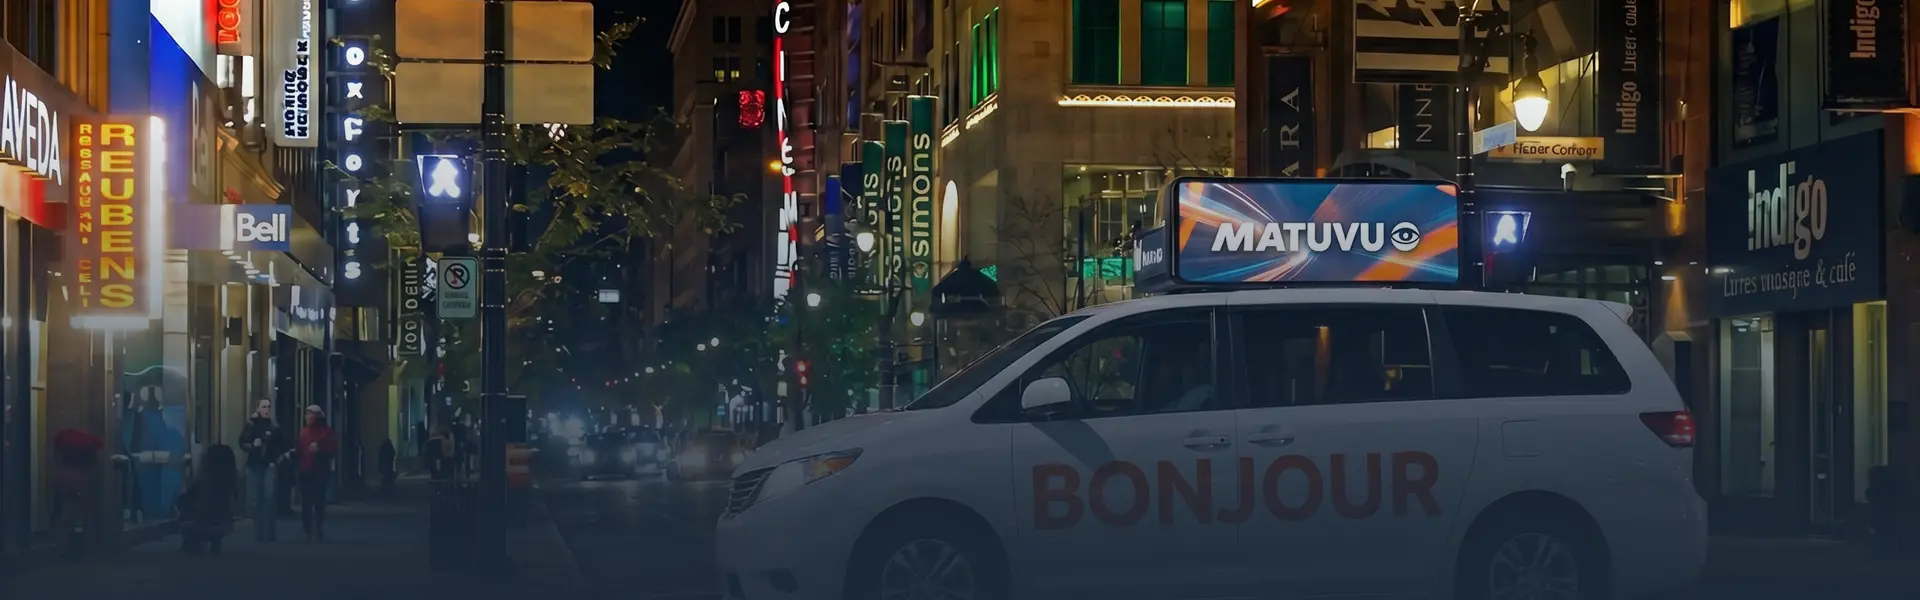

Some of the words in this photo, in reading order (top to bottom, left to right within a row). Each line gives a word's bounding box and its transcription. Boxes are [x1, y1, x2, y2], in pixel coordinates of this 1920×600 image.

[1848, 0, 1881, 59] Indigo
[1, 74, 64, 186] AVEDA
[1616, 81, 1641, 134] Indigo
[99, 124, 135, 308] REUBENS
[236, 213, 287, 242] Bell
[912, 132, 931, 257] simons
[1747, 160, 1828, 260] Indigo
[1210, 221, 1385, 253] MATUVU
[1815, 258, 1828, 288] &
[1031, 450, 1443, 531] BONJOUR
